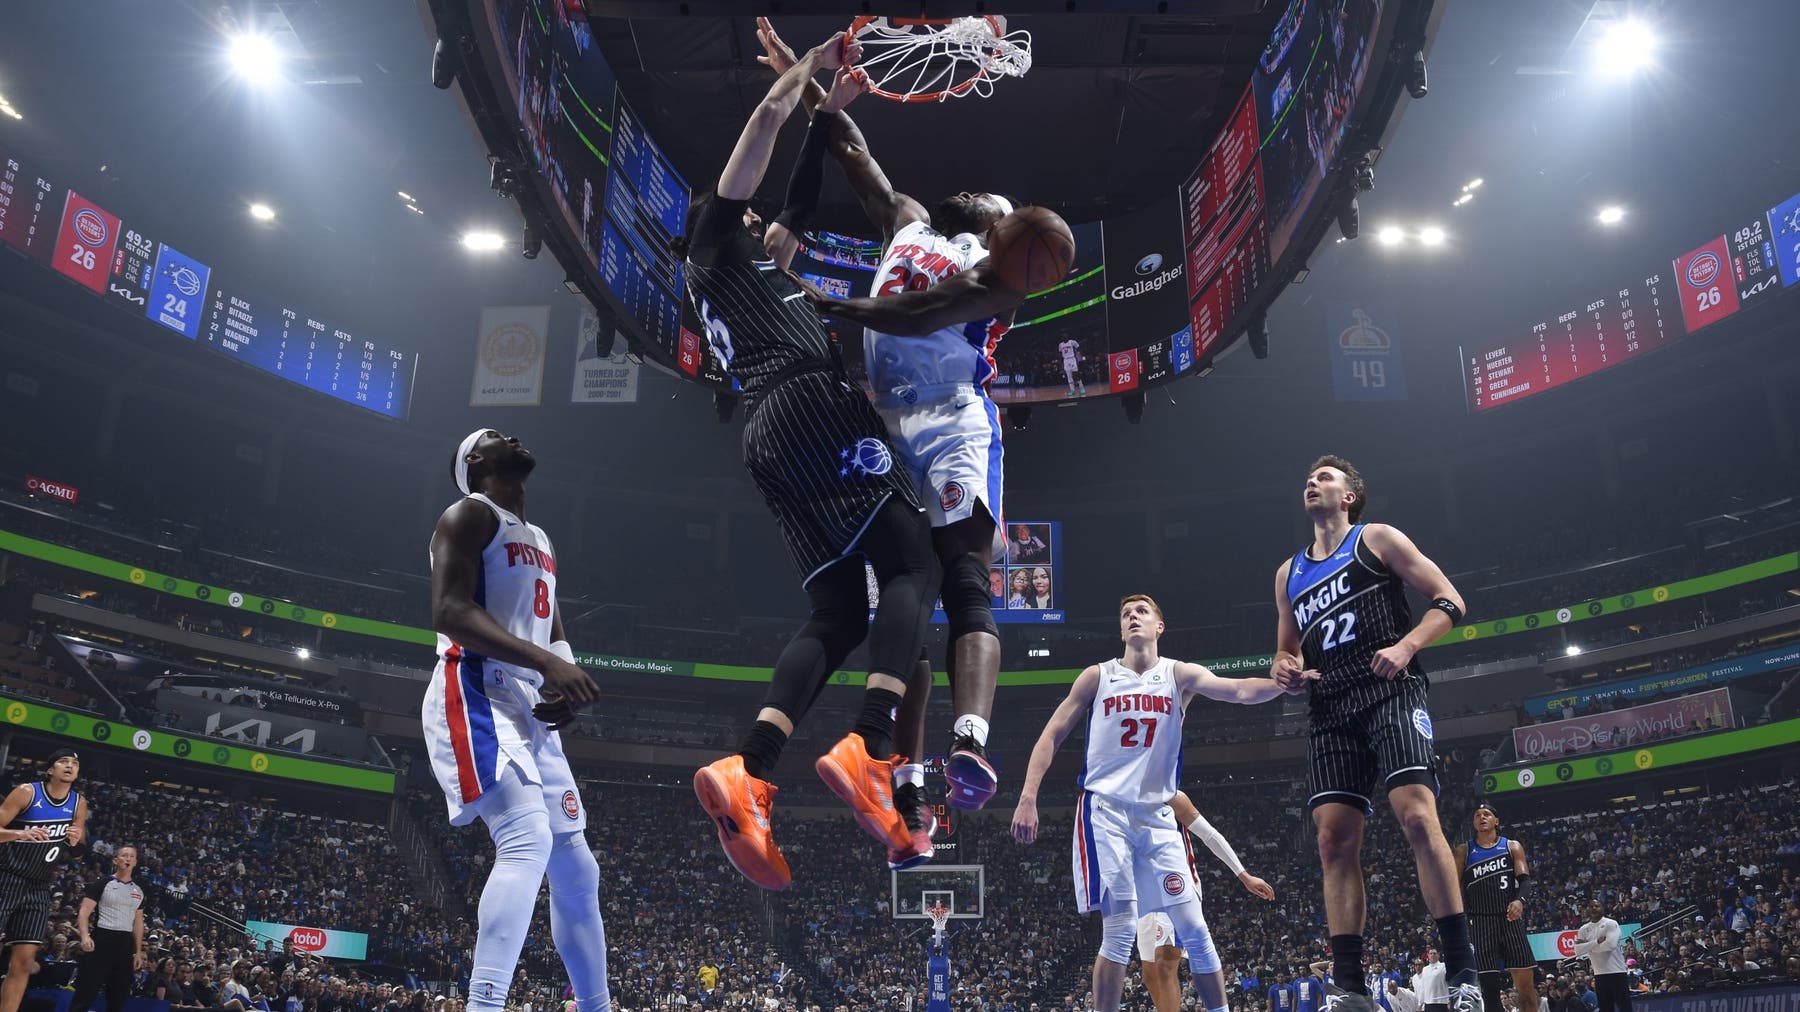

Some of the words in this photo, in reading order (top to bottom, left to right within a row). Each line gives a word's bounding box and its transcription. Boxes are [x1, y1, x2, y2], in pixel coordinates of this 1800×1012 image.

[8, 159, 19, 171] FG
[36, 177, 52, 192] FLS
[126, 230, 153, 252] 49.2
[1734, 221, 1762, 243] 49.2
[1738, 241, 1749, 251] 1ST
[1750, 234, 1763, 245] QTR
[70, 244, 96, 270] 26
[125, 242, 136, 255] 1ST
[136, 247, 149, 260] QTR
[129, 257, 140, 268] FLS
[887, 244, 960, 282] PISTONS
[1747, 250, 1759, 260] FLS
[1111, 264, 1183, 300] Gallagher
[164, 293, 187, 318] 24
[1533, 322, 1547, 333] PTS
[1559, 311, 1577, 324] REBS
[1587, 299, 1605, 312] ASTS
[1619, 289, 1629, 298] FG
[1646, 275, 1660, 286] FLS
[1696, 286, 1721, 312] 26
[215, 301, 223, 311] 35
[228, 307, 253, 324] BITADZE
[362, 361, 372, 371] 0/0
[230, 296, 250, 312] BLACK
[364, 350, 372, 360] 1/3
[282, 308, 296, 320] PTS
[307, 319, 325, 332] REBS
[334, 329, 352, 342] ASTS
[365, 341, 375, 351] FG
[390, 350, 402, 360] FLS
[1486, 348, 1506, 361] LEVERT
[1621, 299, 1630, 309] 1/1
[227, 318, 258, 337] BANCHERO
[360, 371, 369, 381] 1/5
[1148, 342, 1162, 353] 49.2
[1472, 367, 1480, 375] 27
[1487, 356, 1512, 371] HUERTER
[1622, 309, 1633, 320] 0/0
[1474, 377, 1482, 385] 28
[1488, 366, 1514, 380] STEWART
[1624, 320, 1635, 330] 0/0
[210, 322, 218, 332] 22
[225, 328, 250, 345] WAGNER
[359, 381, 367, 391] 1/4
[683, 352, 692, 365] 26
[1180, 350, 1189, 364] 24
[1490, 379, 1508, 391] GREEN
[1626, 330, 1636, 340] 1/2
[222, 339, 239, 352] BANE
[356, 392, 367, 401] 3/6
[584, 369, 609, 379] TURNER
[611, 369, 629, 378] CUP
[1118, 372, 1130, 384] 26
[1352, 361, 1385, 387] 49
[1491, 382, 1530, 401] CUNNINGHAM
[1628, 341, 1639, 351] 3/6
[584, 379, 628, 388] CHAMPIONS
[39, 482, 75, 500] AGMU
[534, 578, 550, 619] 8
[1294, 571, 1351, 631] MAGIC
[1438, 600, 1455, 611] 22
[1321, 612, 1356, 651] 22
[611, 660, 645, 669] Orlando
[648, 663, 672, 673] Magic
[1712, 665, 1744, 677] FESTIVAL
[269, 691, 282, 700] Kia
[284, 694, 317, 707] Telluride
[318, 700, 340, 711] X-Pro
[1103, 693, 1172, 717] PISTONS
[1121, 718, 1158, 748] 27
[1636, 712, 1685, 734] World
[45, 847, 59, 862] 0
[1473, 857, 1507, 878] MAGIC
[1500, 876, 1508, 889] 5
[294, 932, 322, 946] total
